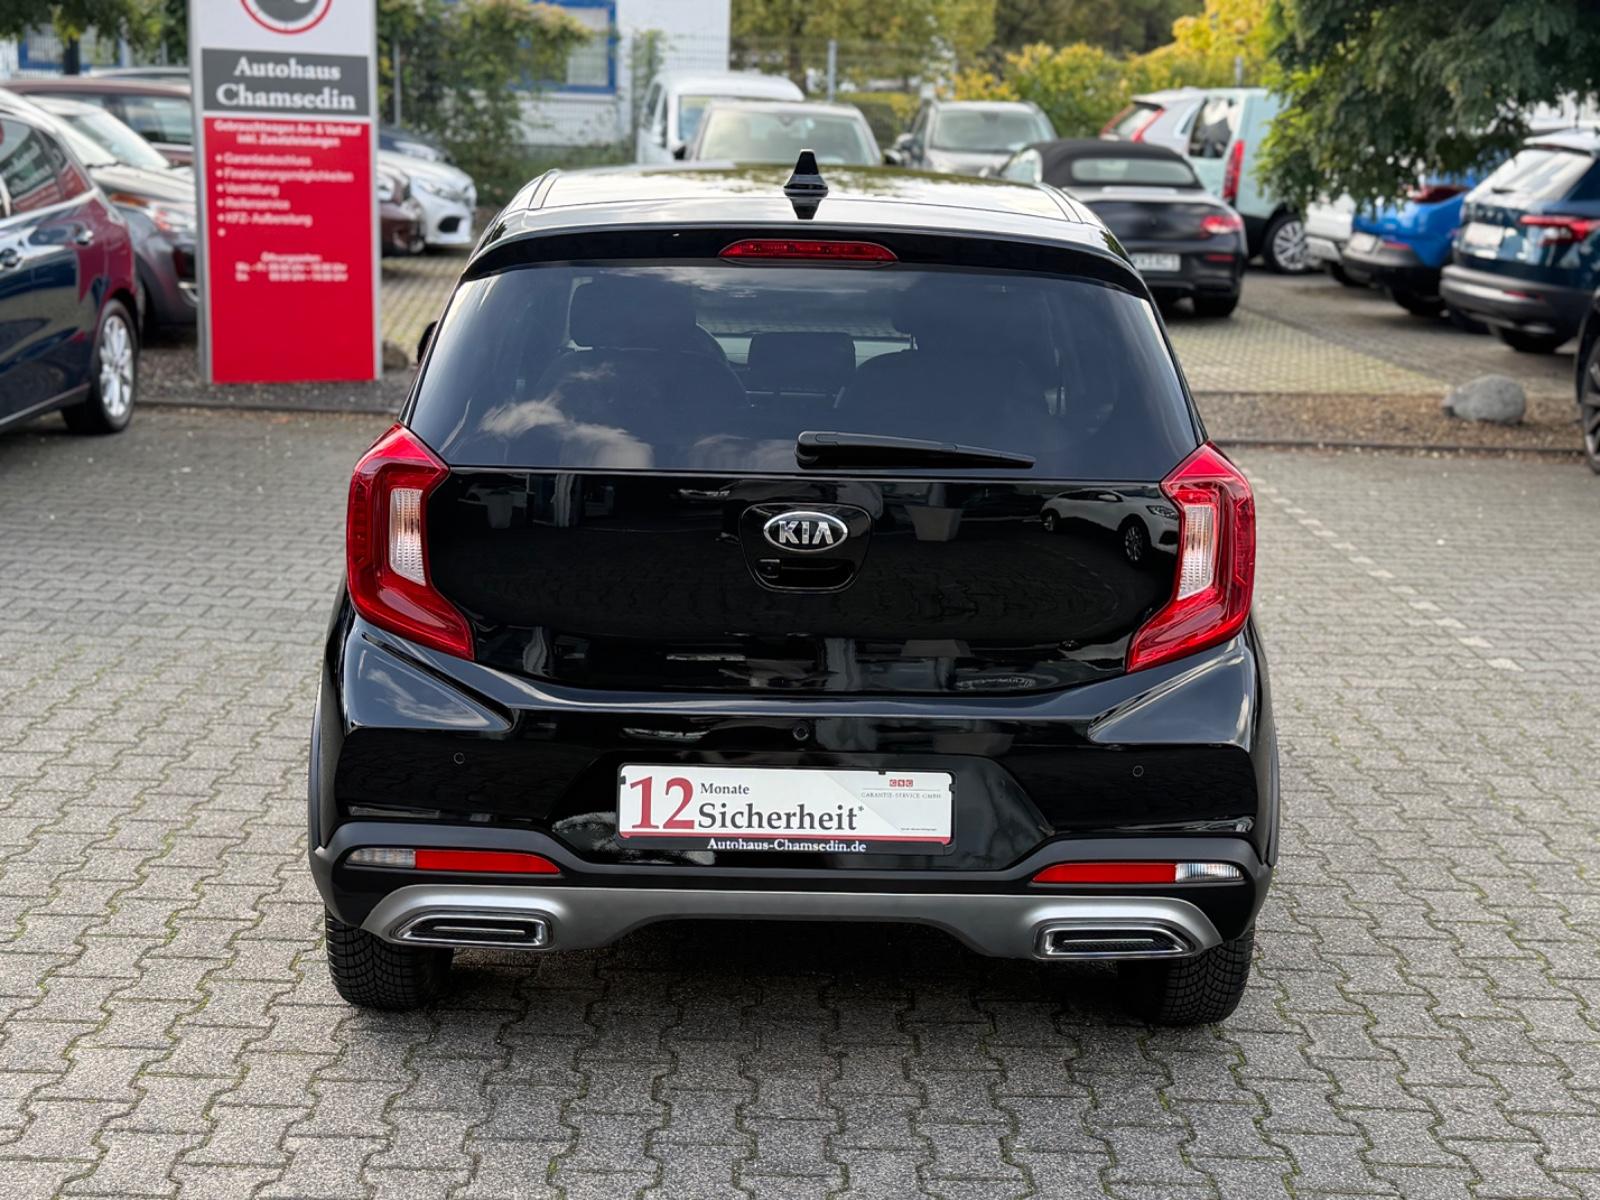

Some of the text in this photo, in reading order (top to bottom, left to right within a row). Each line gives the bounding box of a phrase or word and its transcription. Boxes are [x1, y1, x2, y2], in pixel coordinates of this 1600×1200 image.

[234, 56, 341, 81] Autohaus
[216, 83, 357, 110] Chamsedin
[778, 520, 834, 544] KIA
[700, 783, 750, 795] Monate
[630, 776, 695, 829] 12
[707, 838, 867, 852] Autohaus-Chamsedin.de
